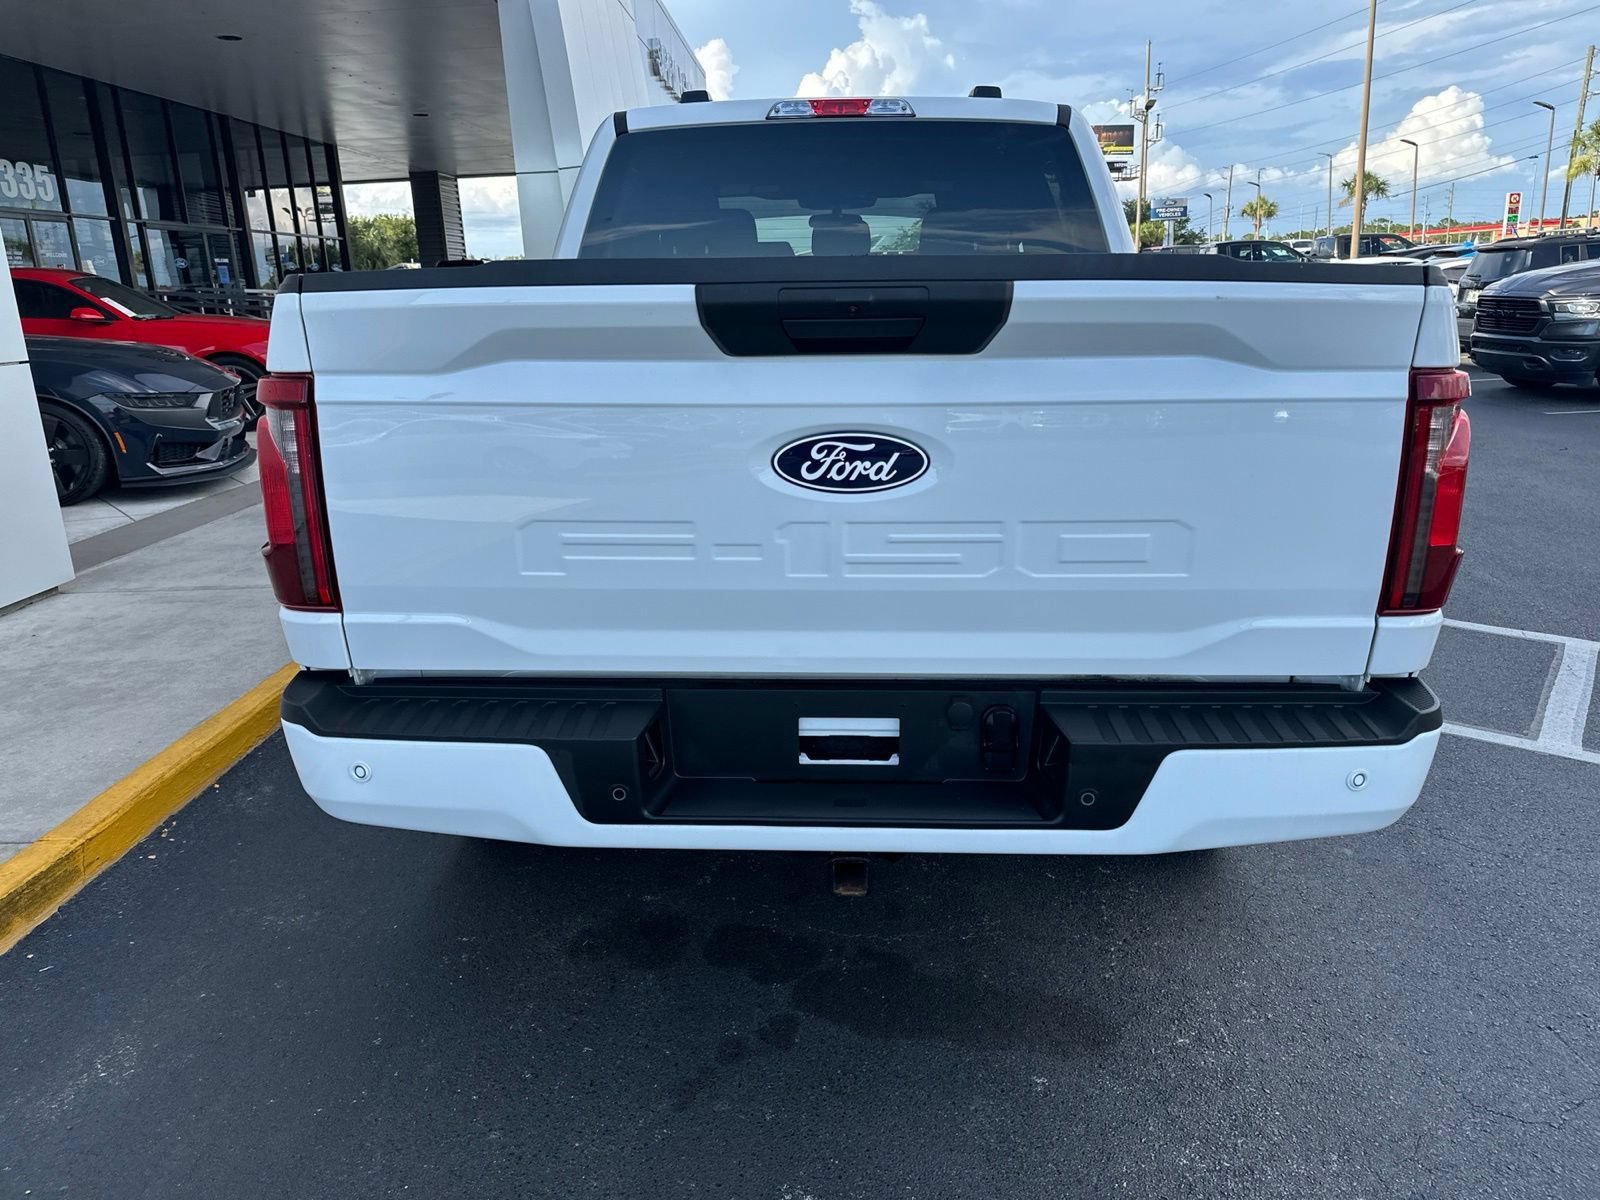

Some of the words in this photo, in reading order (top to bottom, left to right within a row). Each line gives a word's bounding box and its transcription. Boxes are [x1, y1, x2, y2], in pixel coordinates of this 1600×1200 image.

[0, 159, 55, 202] 335
[800, 441, 901, 481] Ford
[515, 519, 1196, 578] F-150
